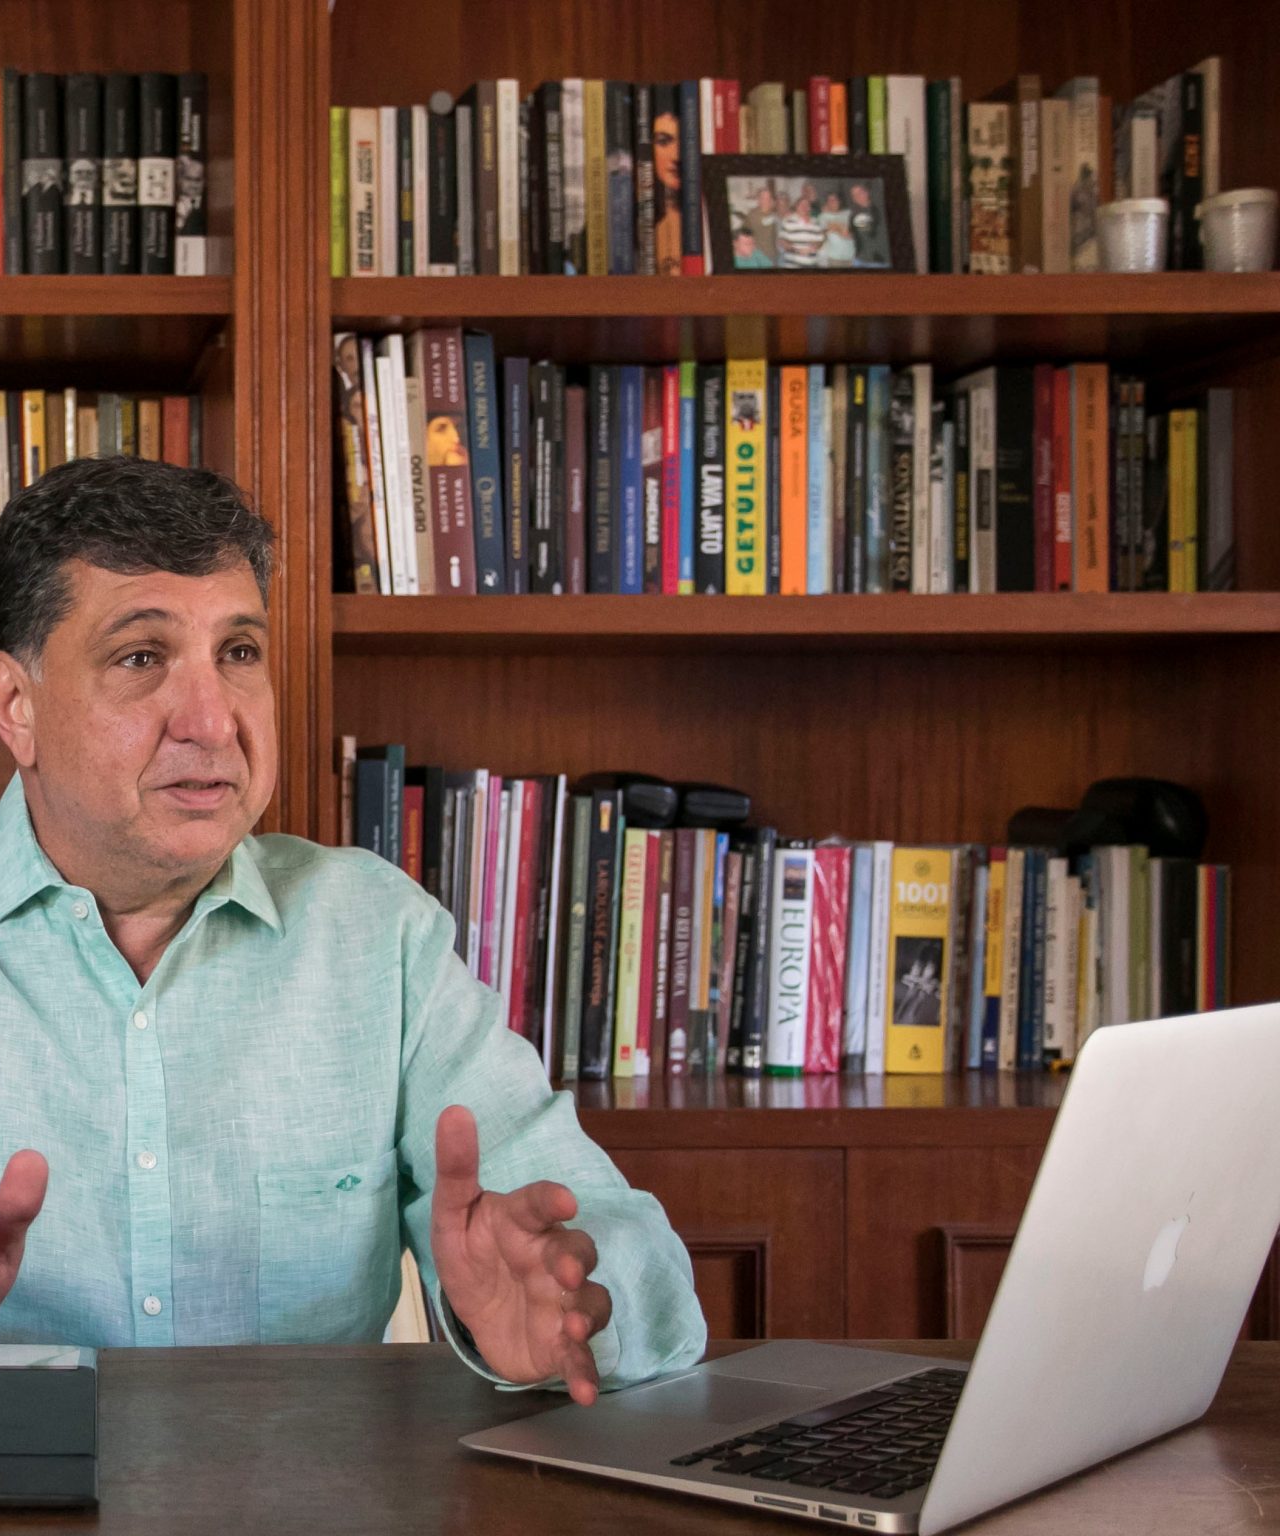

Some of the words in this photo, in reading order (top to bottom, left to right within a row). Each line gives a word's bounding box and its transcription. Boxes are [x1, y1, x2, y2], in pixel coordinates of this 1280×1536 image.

[430, 343, 441, 361] DA
[446, 337, 459, 403] LEONARDO
[431, 363, 443, 398] VINCI
[472, 361, 486, 393] DAN
[704, 377, 720, 424] Vladimir
[475, 397, 490, 449] BROWN
[789, 379, 802, 438] GUGA
[411, 455, 427, 533] DEPUTADO
[436, 473, 449, 533] ISAACSON
[453, 478, 465, 527] WALTER
[701, 464, 723, 507] LAVA
[701, 509, 723, 554] JATO
[592, 860, 609, 937] LAROUSSE
[895, 881, 950, 904] 1001
[778, 908, 805, 1025] EUROPA
